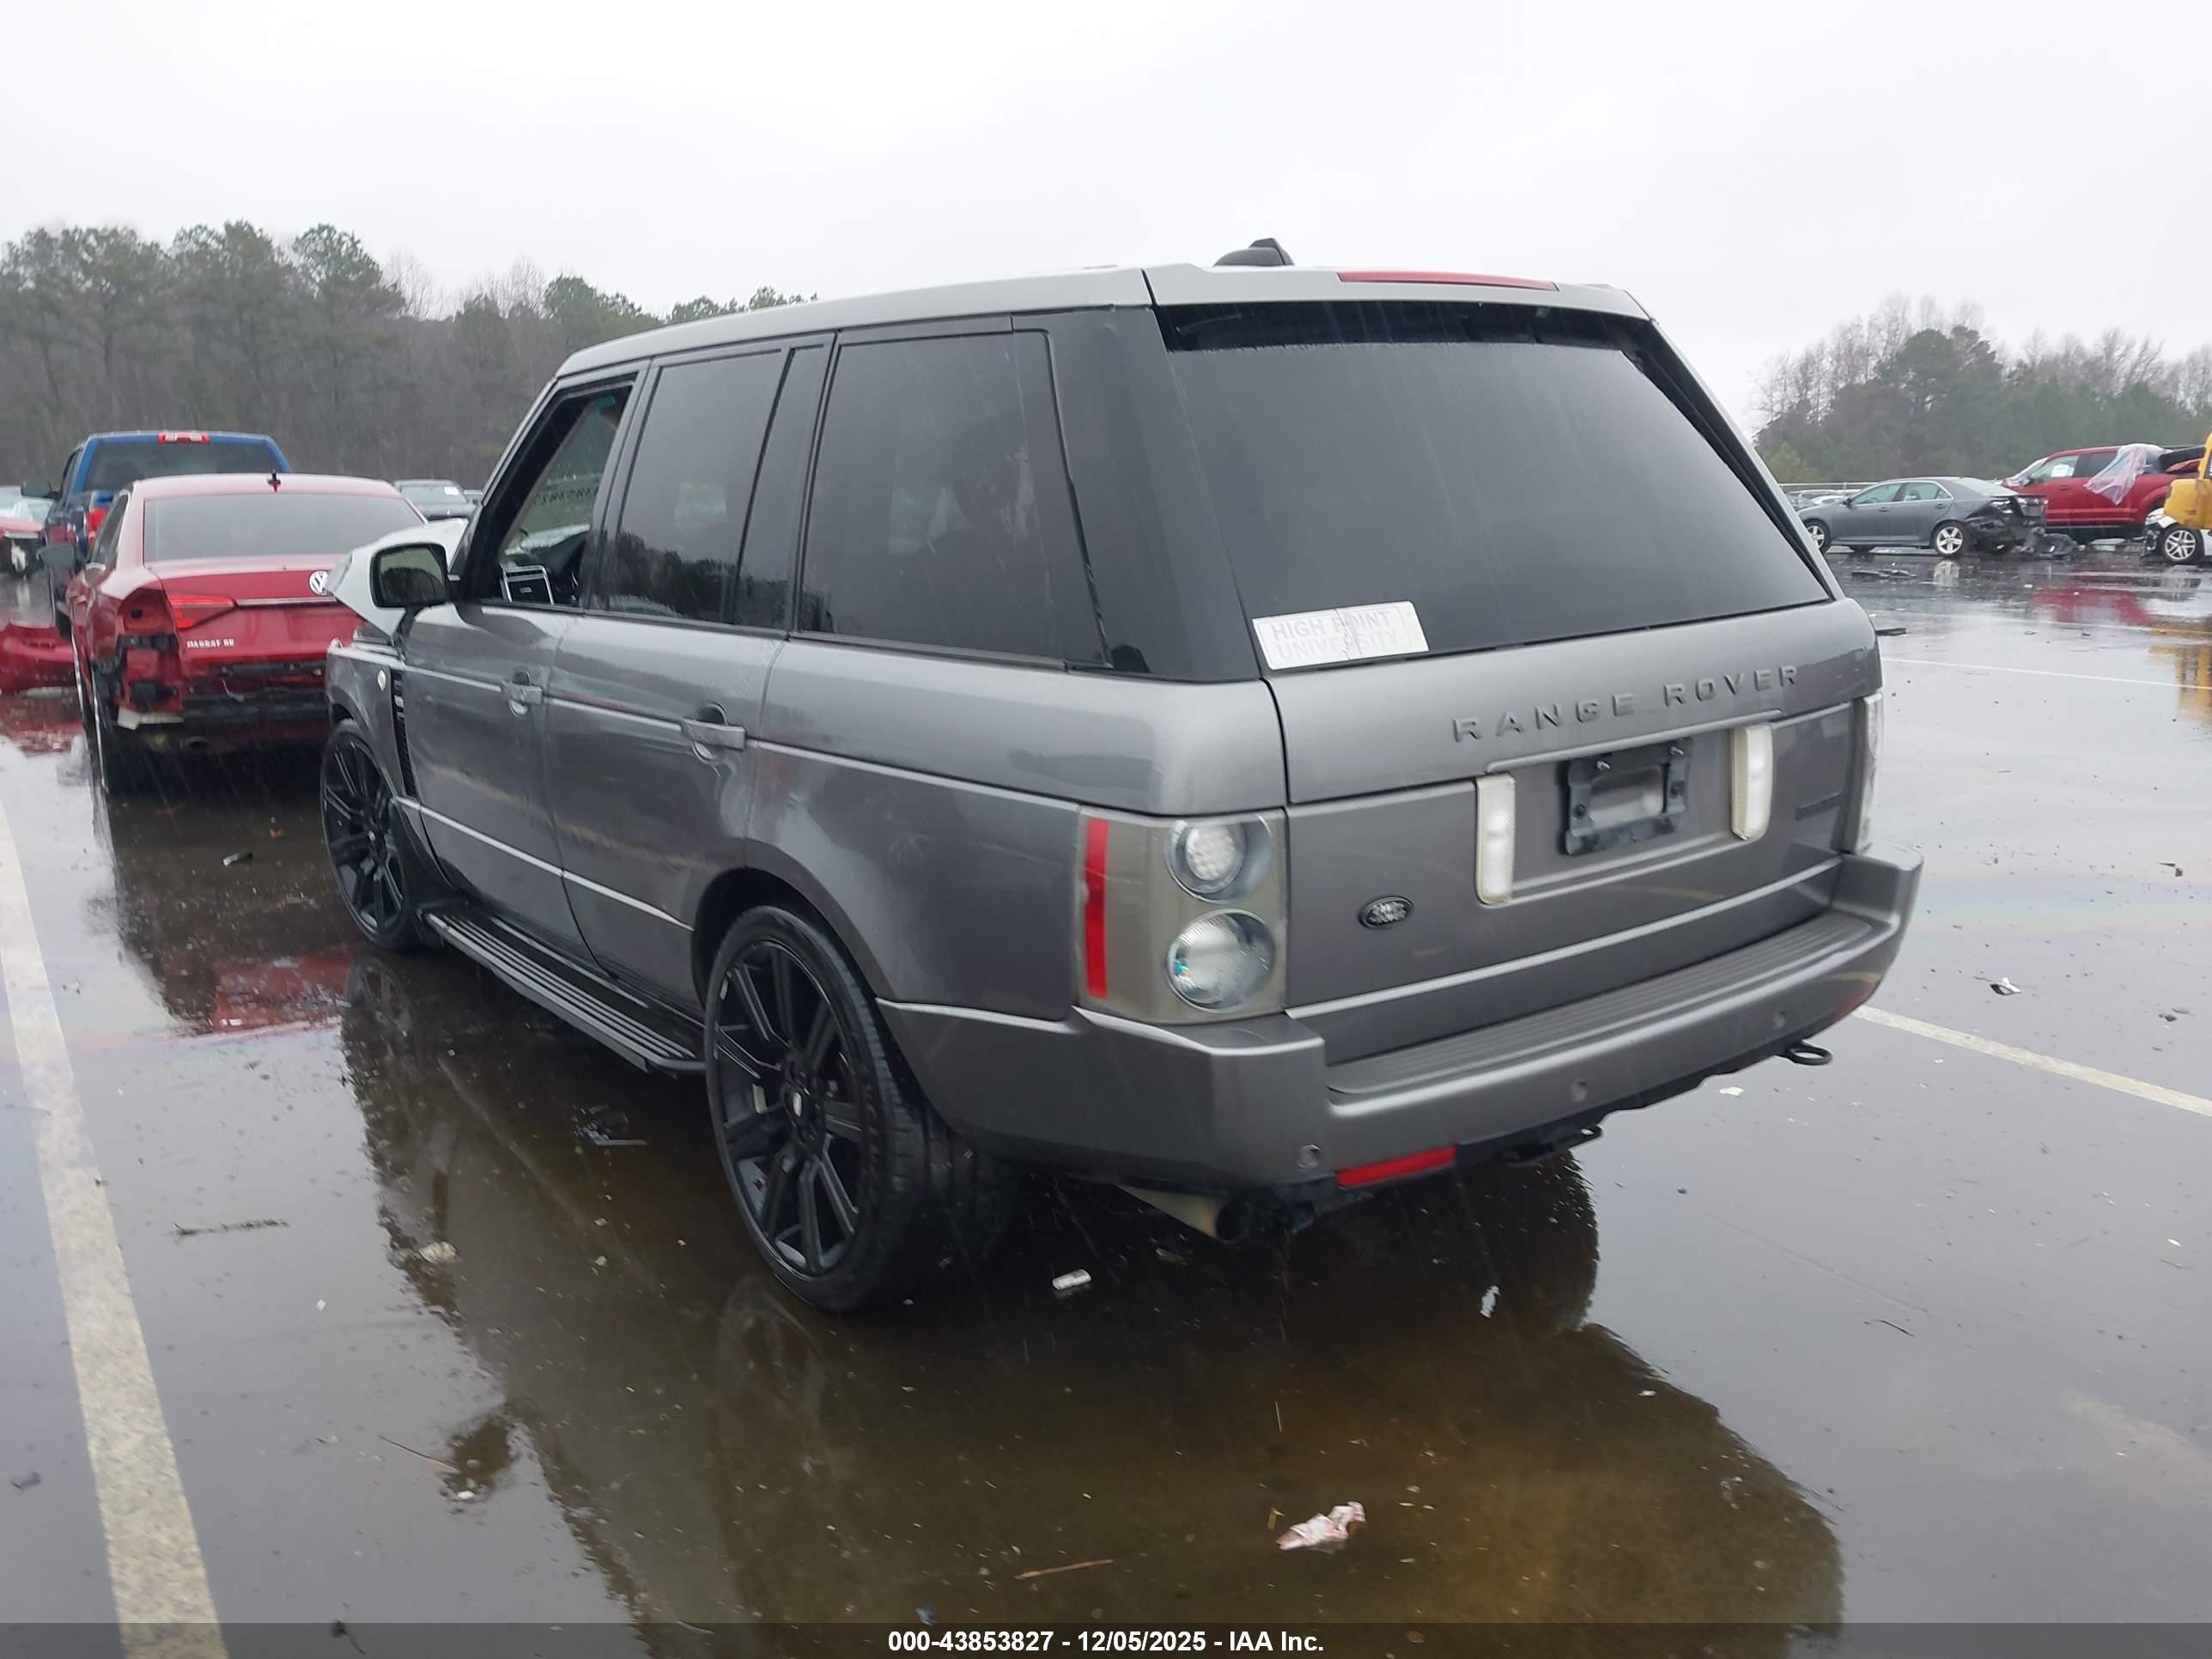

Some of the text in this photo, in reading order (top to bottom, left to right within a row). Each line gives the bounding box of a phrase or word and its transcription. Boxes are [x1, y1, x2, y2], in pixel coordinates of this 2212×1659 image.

[1271, 611, 1391, 641] HIGH POINT
[1452, 665, 1798, 743] RANGE ROVER
